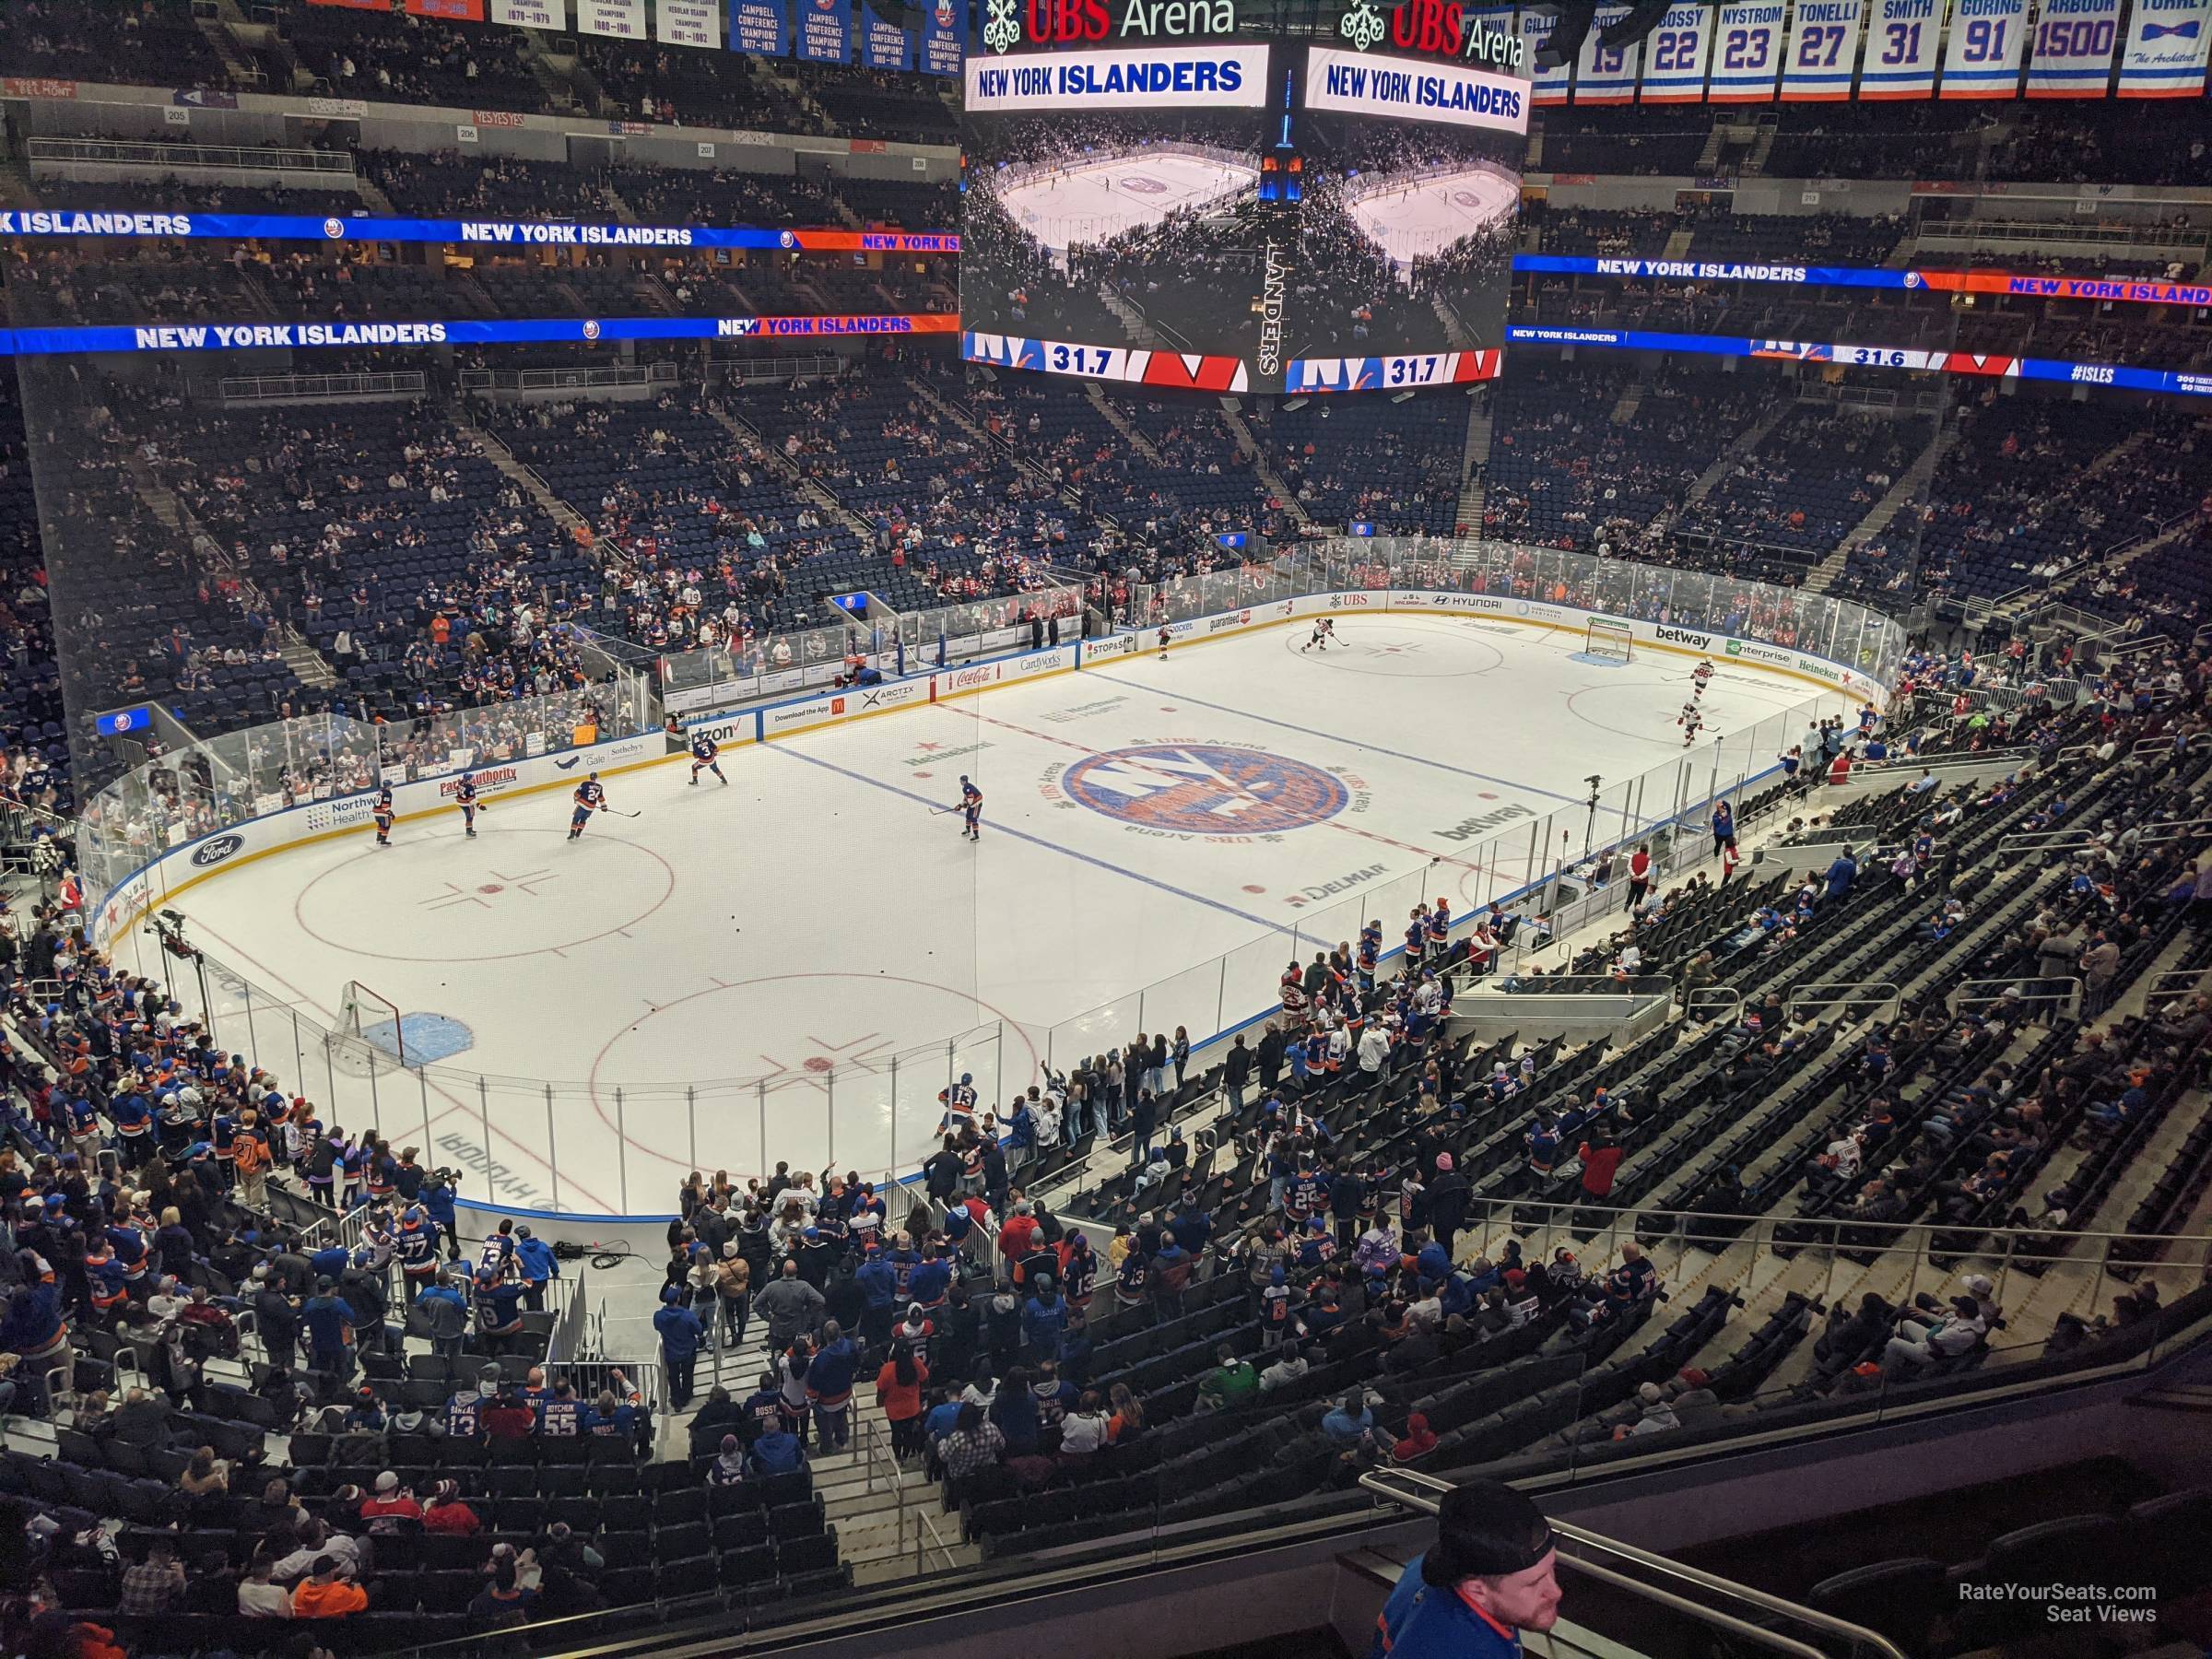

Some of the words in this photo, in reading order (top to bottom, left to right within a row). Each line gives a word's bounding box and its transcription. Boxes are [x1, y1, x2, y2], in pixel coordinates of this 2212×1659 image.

[597, 9, 626, 18] CHAMPIONS
[741, 4, 775, 18] CAMPBELL
[1722, 6, 1783, 24] NYSTROM
[1798, 2, 1859, 22] TONELLI
[1883, 0, 1933, 19] SMITH
[1960, 0, 2023, 17] GORING
[676, 18, 702, 29] CHAMPIONS
[738, 16, 778, 29] CONFERENCE
[808, 13, 840, 26] CAMPBELL
[1027, 0, 1112, 43] UBS
[1120, 0, 1235, 37] Arena
[1658, 9, 1704, 29] BOSSY
[740, 27, 777, 40] CHAMPIONS
[805, 24, 843, 37] CONFERENCE
[869, 33, 905, 45] CONFERENCE
[936, 30, 954, 41] WALES
[1393, 0, 1465, 55] UBS
[1465, 18, 1524, 67] Arena
[2034, 20, 2116, 58] 1500
[806, 35, 841, 48] CHAMPIONS
[871, 43, 903, 56] CHAMPIONS
[928, 40, 961, 53] CONFERENCE
[1724, 28, 1771, 69] 23
[1797, 26, 1846, 67] 27
[1881, 22, 1923, 65] 31
[1963, 19, 2006, 62] 91
[929, 50, 959, 62] CHAMPIONS
[1654, 31, 1699, 71] 22
[979, 68, 1009, 97] NEW
[1012, 67, 1053, 96] YORK
[1059, 60, 1242, 95] ISLANDERS
[1327, 65, 1367, 98] NEW
[1371, 69, 1412, 103] YORK
[1416, 76, 1521, 119] ISLANDERS
[169, 112, 185, 121] 205
[700, 146, 712, 155] 207
[20, 212, 192, 235] ISLANDERS
[462, 223, 512, 241] NEW
[519, 224, 577, 243] YORK
[581, 226, 692, 246] ISLANDERS
[863, 235, 897, 250] NEW
[902, 236, 935, 251] YORK
[1597, 259, 1639, 275] NEW
[1643, 260, 1694, 277] YORK
[1698, 264, 1806, 282] ISLANDERS
[2009, 278, 2061, 294] NEW
[2067, 280, 2124, 297] YORK
[2129, 286, 2212, 304] ISLAND
[718, 317, 760, 335] NEW
[766, 317, 814, 335] YORK
[818, 316, 912, 334] ISLANDERS
[135, 327, 207, 348] NEW
[214, 325, 290, 347] YORK
[298, 324, 446, 345] ISLANDERS
[1512, 329, 1535, 338] NEW
[1536, 330, 1563, 339] YORK
[1563, 331, 1618, 342] ISLANDERS
[1053, 346, 1112, 375] 31.7
[1853, 348, 1905, 367] 31.6
[1391, 357, 1438, 384] 31.7
[2071, 365, 2114, 383] #ISLES
[2177, 375, 2194, 383] 300
[1343, 594, 1368, 606] UBS
[1453, 598, 1501, 609] HYUNDAI
[1209, 615, 1240, 631] guaranteed
[1656, 626, 1712, 650] betway
[1728, 641, 1792, 664] enterprise
[1020, 653, 1061, 672] CardWorks
[1798, 658, 1839, 680] Heineken
[880, 685, 914, 699] ARCTIX
[774, 710, 806, 723] Download
[806, 708, 817, 716] the
[817, 705, 830, 715] App
[611, 744, 643, 756] Sotheby's
[903, 741, 995, 766] Heineken
[586, 756, 606, 766] Gale
[1038, 762, 1066, 782] Arena
[332, 797, 373, 814] Northw
[1350, 791, 1373, 812] Arena
[1431, 803, 1537, 841] betway
[200, 839, 232, 863] Ford
[1300, 863, 1391, 900] DELMAR
[236, 1143, 252, 1159] 27
[435, 1132, 538, 1200] HYUNDAI
[1298, 1182, 1316, 1192] NELSON
[404, 1239, 428, 1258] 77
[484, 1241, 502, 1250] BARZAL
[755, 1406, 778, 1417] BOSSY
[544, 1414, 577, 1436] 55
